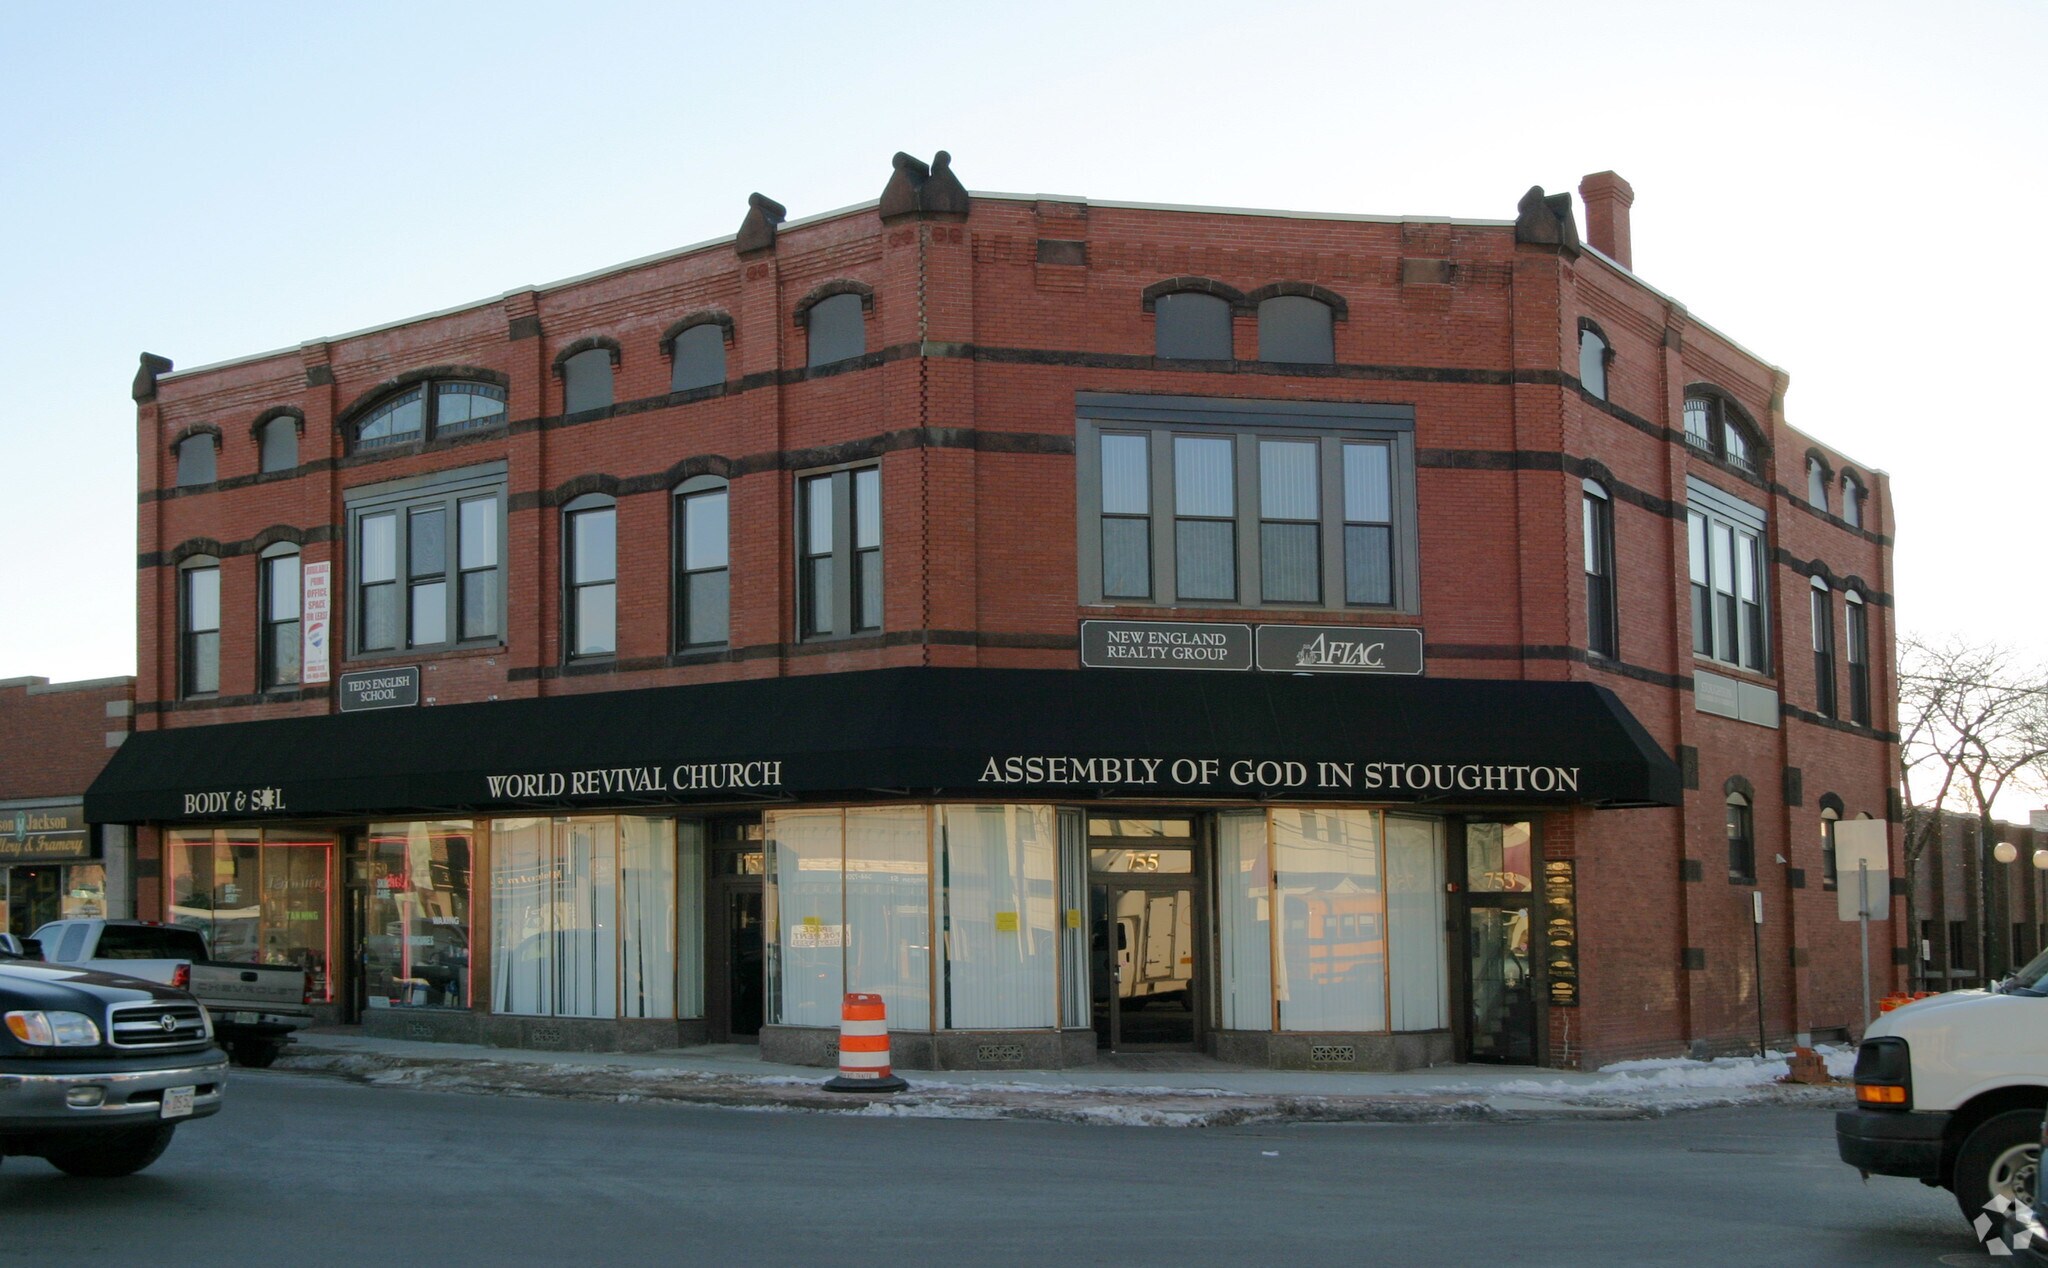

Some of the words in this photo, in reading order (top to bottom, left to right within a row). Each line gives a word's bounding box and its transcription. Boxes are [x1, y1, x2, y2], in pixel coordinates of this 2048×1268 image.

[307, 588, 327, 598] OFFICE
[308, 600, 326, 610] SPACE
[1107, 631, 1145, 644] NEW
[1147, 632, 1227, 646] ENGLAND
[1107, 645, 1169, 659] REALTY
[1172, 647, 1228, 660] GROUP
[348, 680, 372, 692] TED'S
[372, 676, 410, 689] ENGLISH
[360, 689, 397, 702] SCHOOL
[486, 772, 565, 798] WORLD
[571, 766, 667, 795] REVIVAL
[673, 761, 782, 790] CHURCH
[978, 756, 1164, 785] ASSEMBLY
[1171, 759, 1219, 785] OF
[1229, 759, 1307, 787] GOD
[1316, 762, 1355, 787] IN
[1365, 762, 1581, 792] STOUGHTON
[184, 791, 231, 814] BODY
[234, 790, 247, 812] &
[26, 812, 68, 831] Jackson
[24, 835, 34, 852] &
[36, 834, 83, 856] Framery
[1125, 853, 1159, 871] 755
[1484, 871, 1516, 889] 753
[432, 916, 460, 925] WAXING
[197, 982, 299, 995] CHEVROLET
